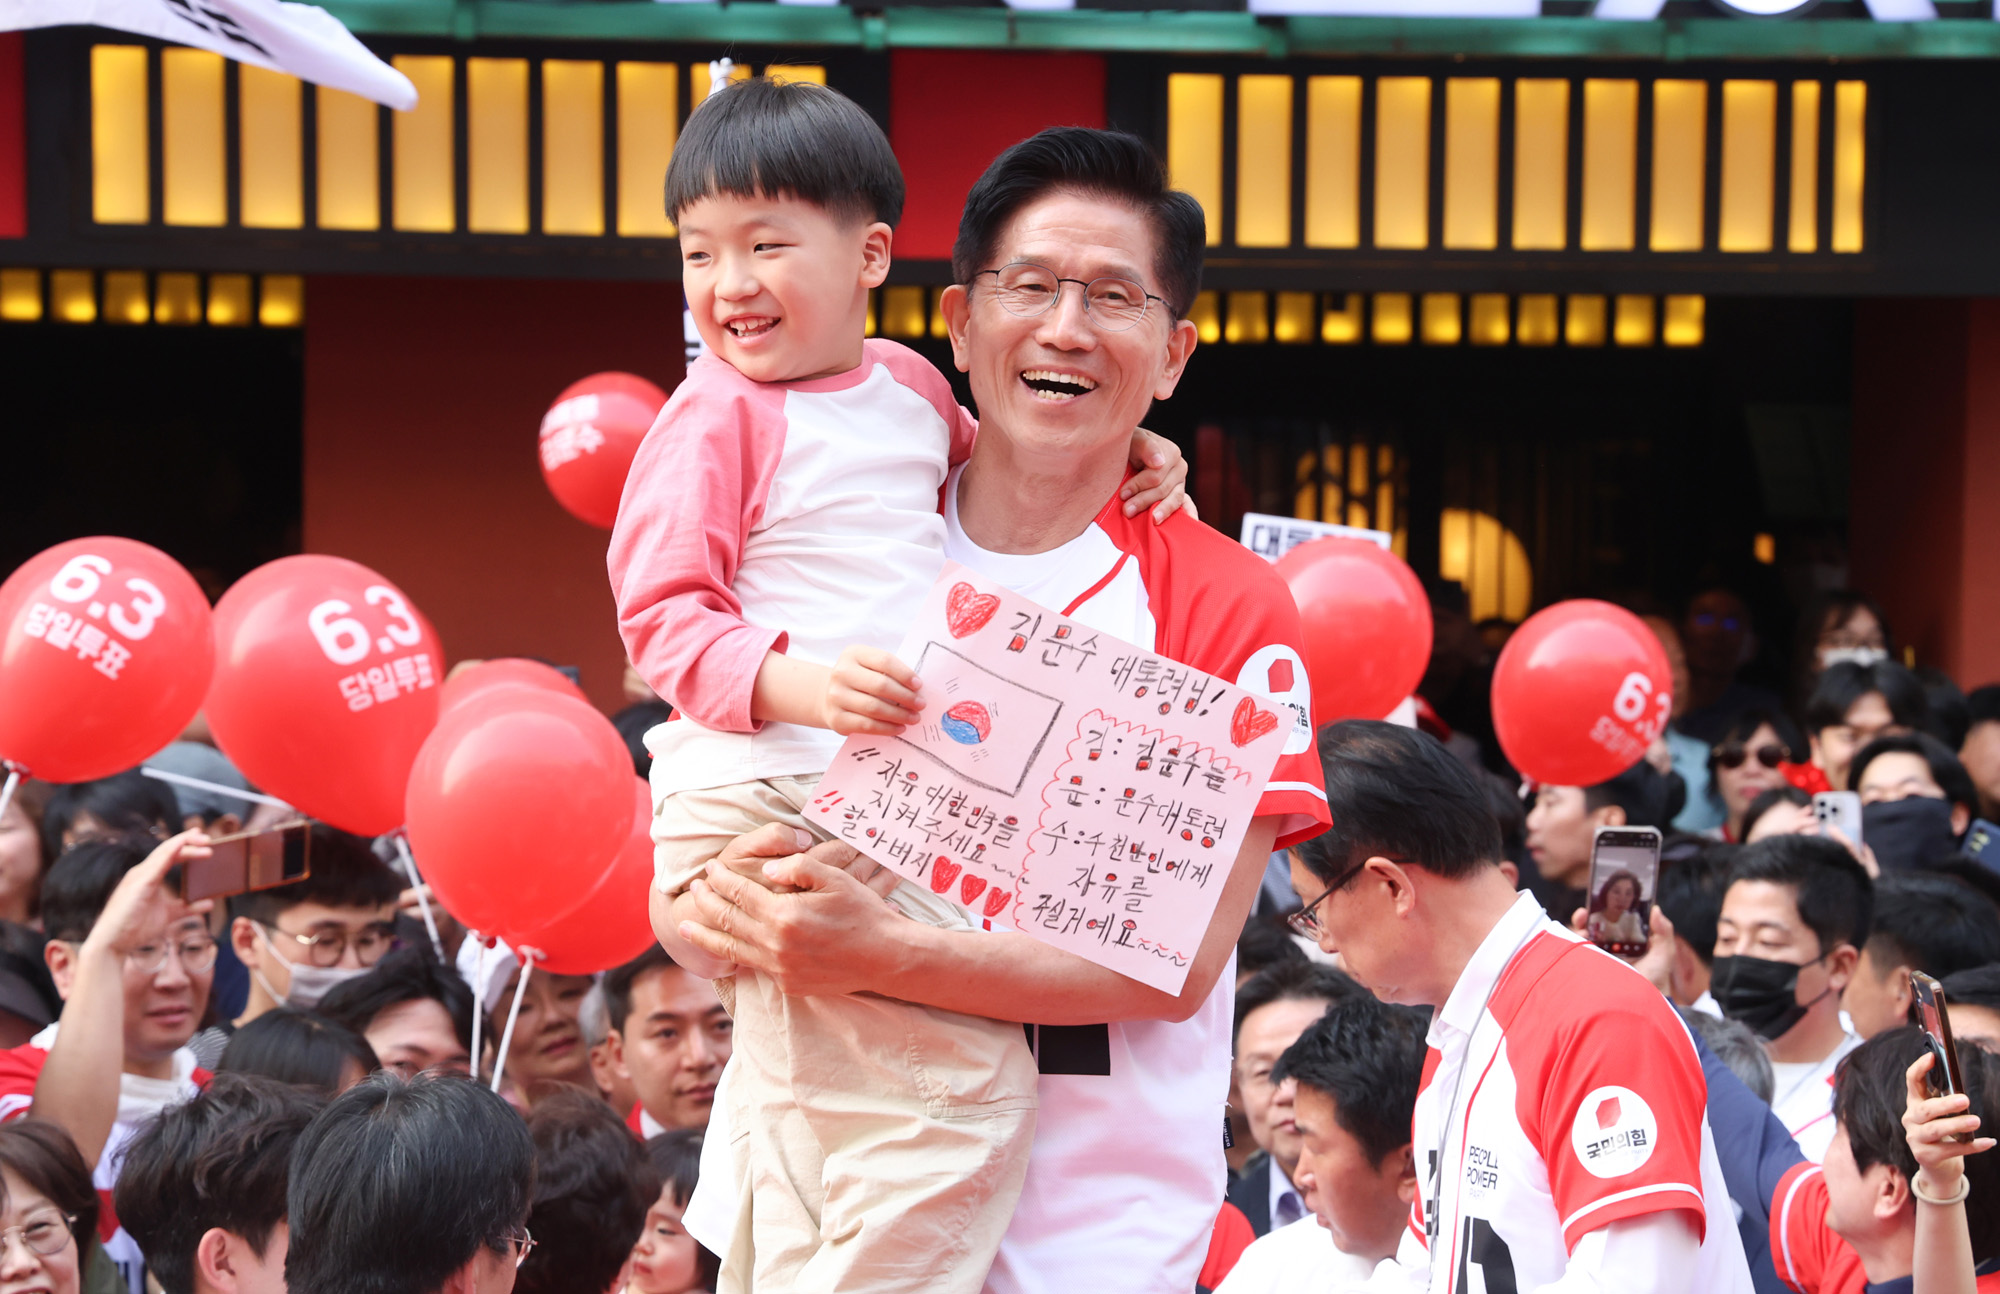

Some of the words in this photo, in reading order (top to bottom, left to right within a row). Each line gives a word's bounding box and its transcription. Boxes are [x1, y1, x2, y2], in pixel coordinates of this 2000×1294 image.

[50, 554, 166, 641] 6.3
[308, 585, 422, 666] 6.3
[23, 602, 132, 680] 당일투표
[1007, 611, 1099, 673] 김문수
[1110, 655, 1226, 717] 대통령님!
[338, 653, 435, 713] 당일투표
[1613, 671, 1672, 741] 6.3
[877, 758, 919, 797] 자유
[925, 784, 1020, 849] 대한민국을
[1114, 787, 1228, 849] 문수대통령
[841, 805, 933, 878] 할아버지
[1067, 863, 1154, 913] 자유를
[1466, 1165, 1499, 1190] POWER
[1586, 1128, 1648, 1160] 국민의힘
